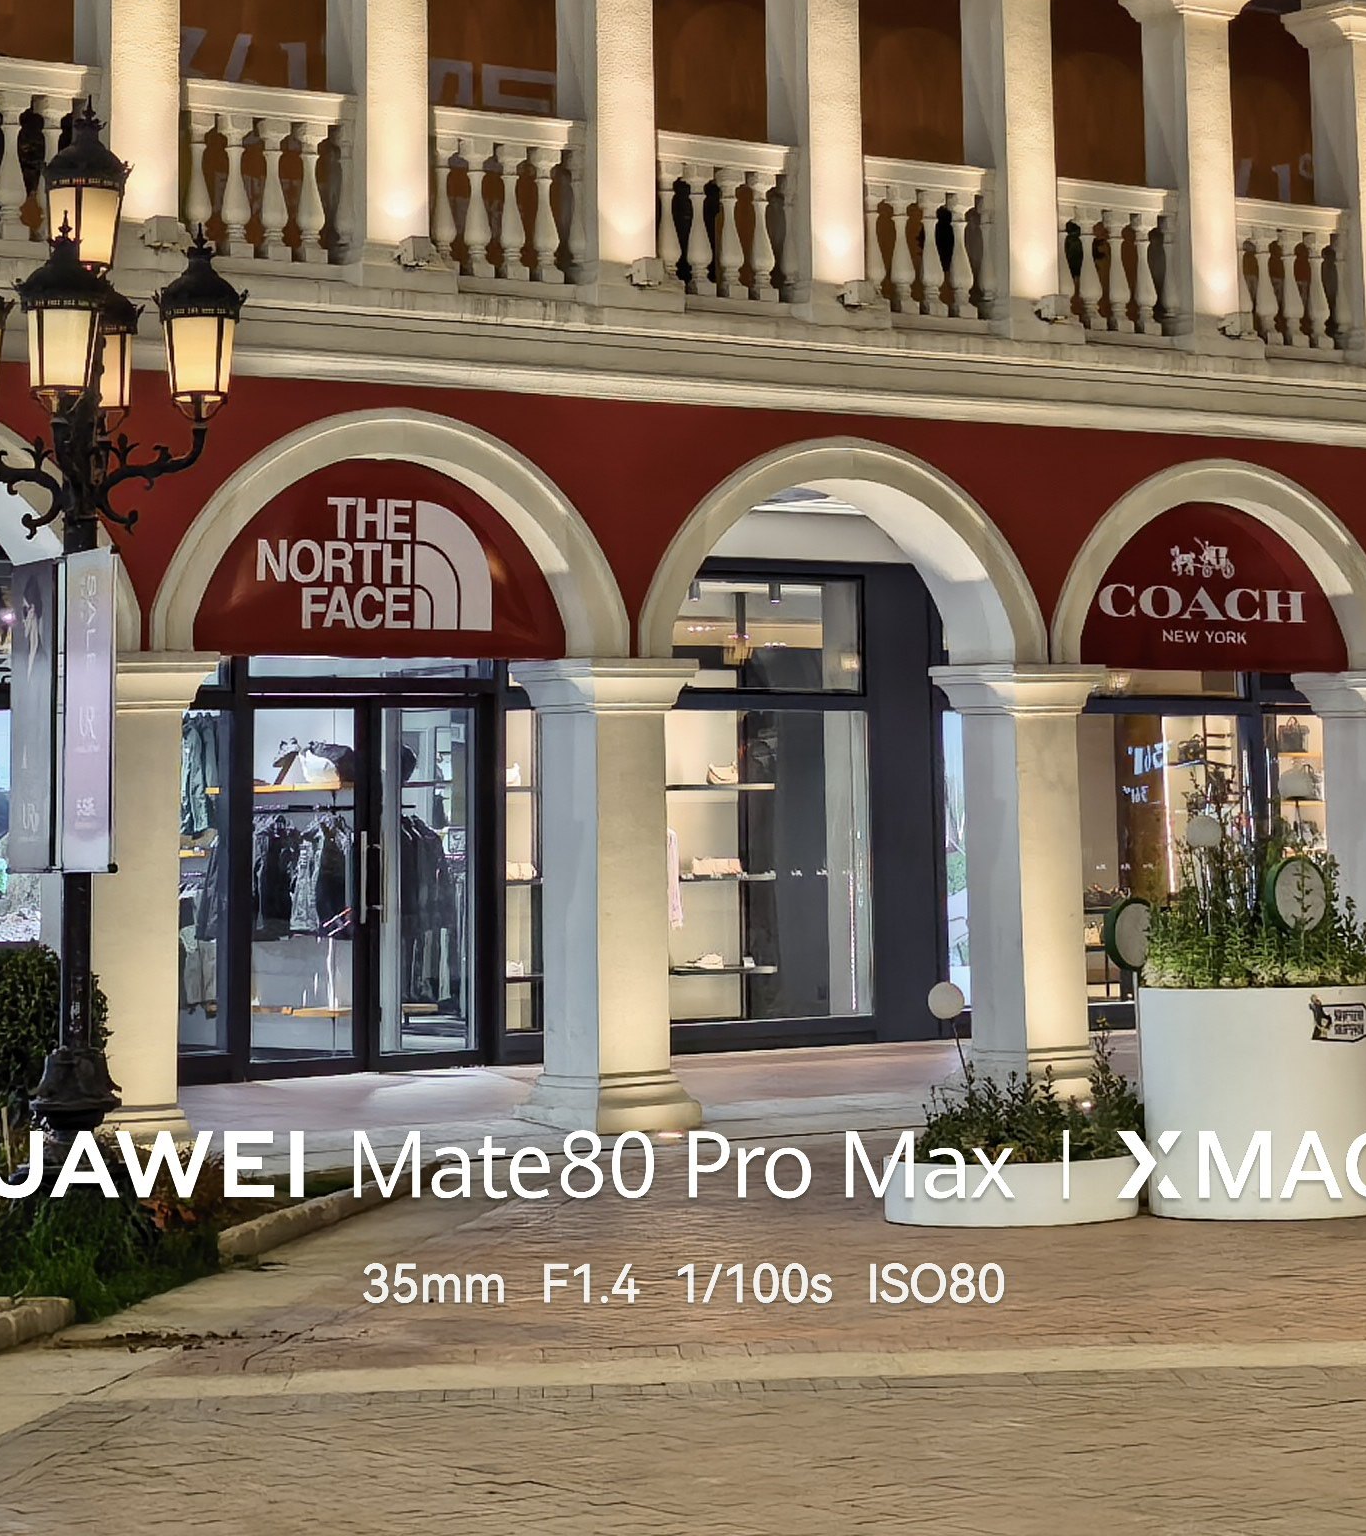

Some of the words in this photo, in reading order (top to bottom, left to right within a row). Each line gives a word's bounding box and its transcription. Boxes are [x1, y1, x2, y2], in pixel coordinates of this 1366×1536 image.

[327, 496, 413, 541] THE
[256, 538, 412, 585] NORTH
[85, 574, 98, 668] SALE
[301, 585, 412, 630] FACE
[1098, 583, 1308, 624] COACH
[1162, 629, 1200, 644] NEW
[1205, 630, 1248, 646] YORK
